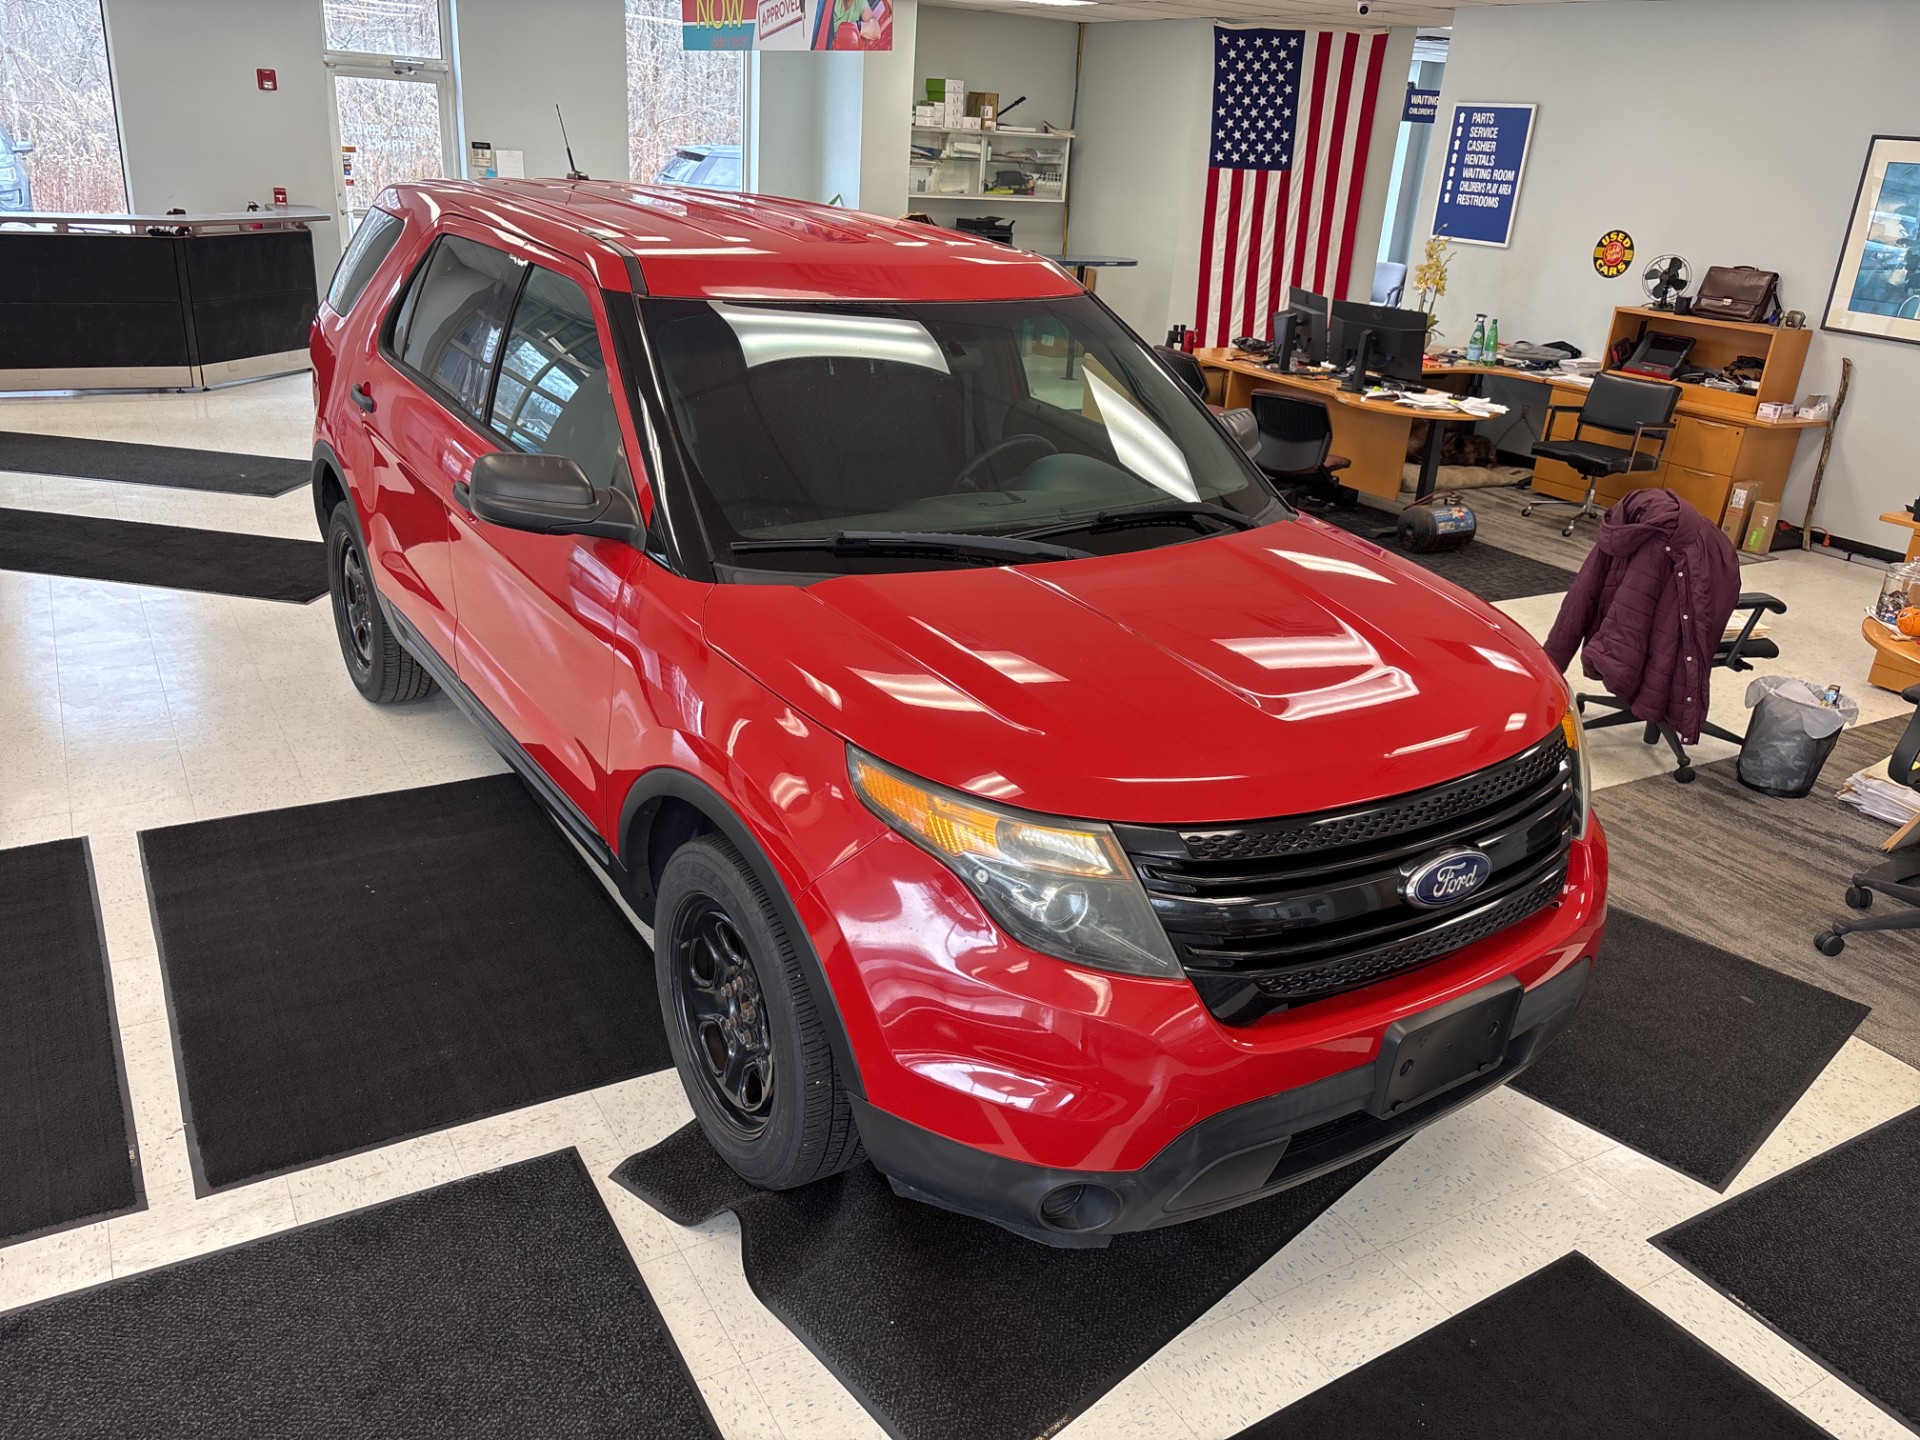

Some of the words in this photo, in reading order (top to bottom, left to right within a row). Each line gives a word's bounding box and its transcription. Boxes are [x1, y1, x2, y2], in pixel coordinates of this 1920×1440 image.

[696, 0, 744, 30] NOW
[1411, 94, 1439, 106] WAITING
[1472, 113, 1495, 124] PARTS
[1469, 127, 1498, 139] SERVICE
[1467, 141, 1496, 152] CASHIER
[1464, 154, 1495, 166] RENTALS
[1462, 167, 1491, 180] WAITING
[1492, 169, 1515, 182] ROOM
[1459, 180, 1486, 194] CHILDREN'S
[1486, 182, 1499, 195] PLAY
[1498, 183, 1512, 196] AREA
[1456, 194, 1499, 208] RESTROOMS
[1602, 232, 1631, 248] USED
[1596, 259, 1626, 275] CARS
[1433, 862, 1477, 897] Ford
